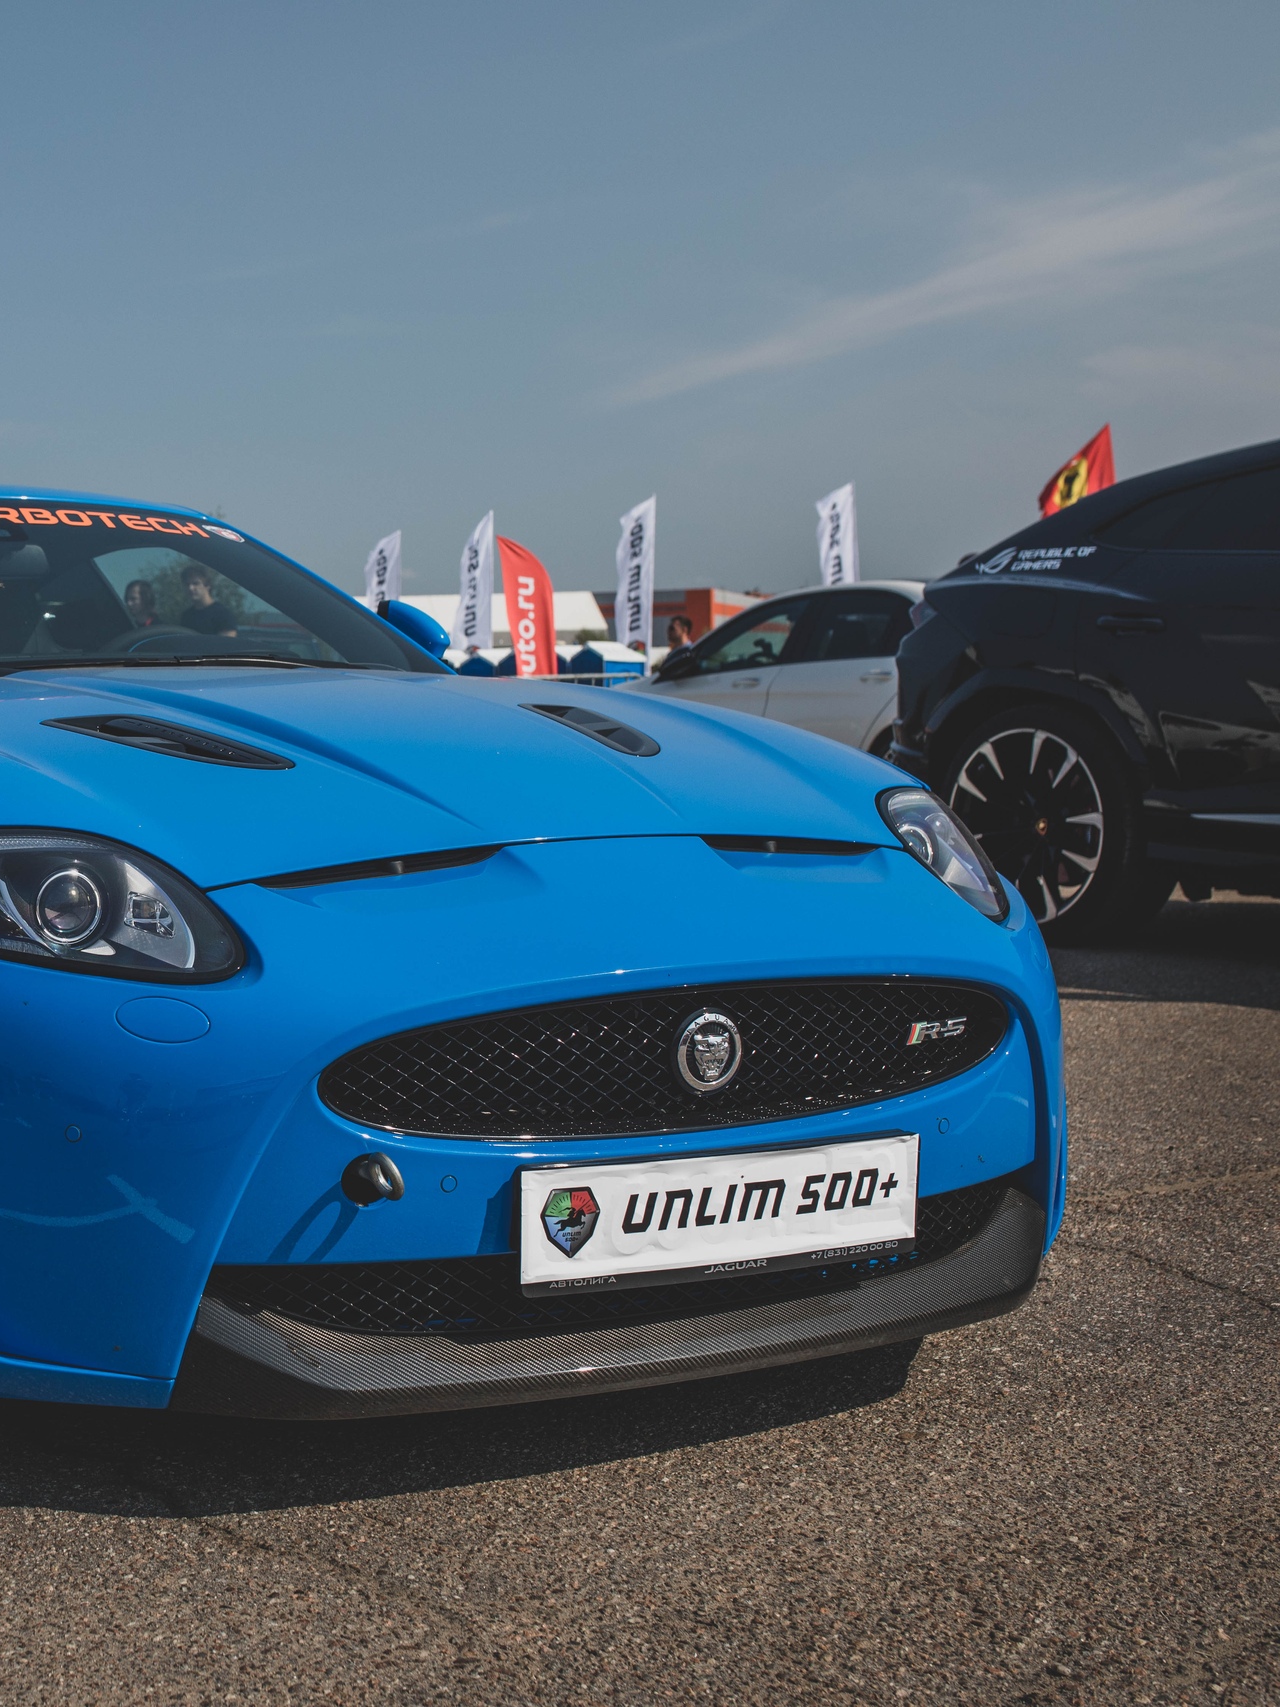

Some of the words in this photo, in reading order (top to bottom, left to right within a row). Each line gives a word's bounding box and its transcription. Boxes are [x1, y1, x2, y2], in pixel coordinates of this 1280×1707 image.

[1018, 547, 1077, 560] REPUBLIC
[1077, 546, 1097, 558] OF
[1011, 559, 1061, 572] GAMERS
[517, 576, 537, 679] uto.ru
[686, 1014, 738, 1035] JAGUAR
[622, 1179, 786, 1234] UNLIM
[796, 1168, 899, 1215] 500+
[811, 1252, 822, 1260] +7
[823, 1247, 847, 1259] (831)
[849, 1245, 868, 1254] 220
[870, 1243, 883, 1251] 00
[885, 1241, 898, 1249] 80
[704, 1259, 767, 1274] JAGUAR
[549, 1276, 617, 1288] АВТОЛИГА
